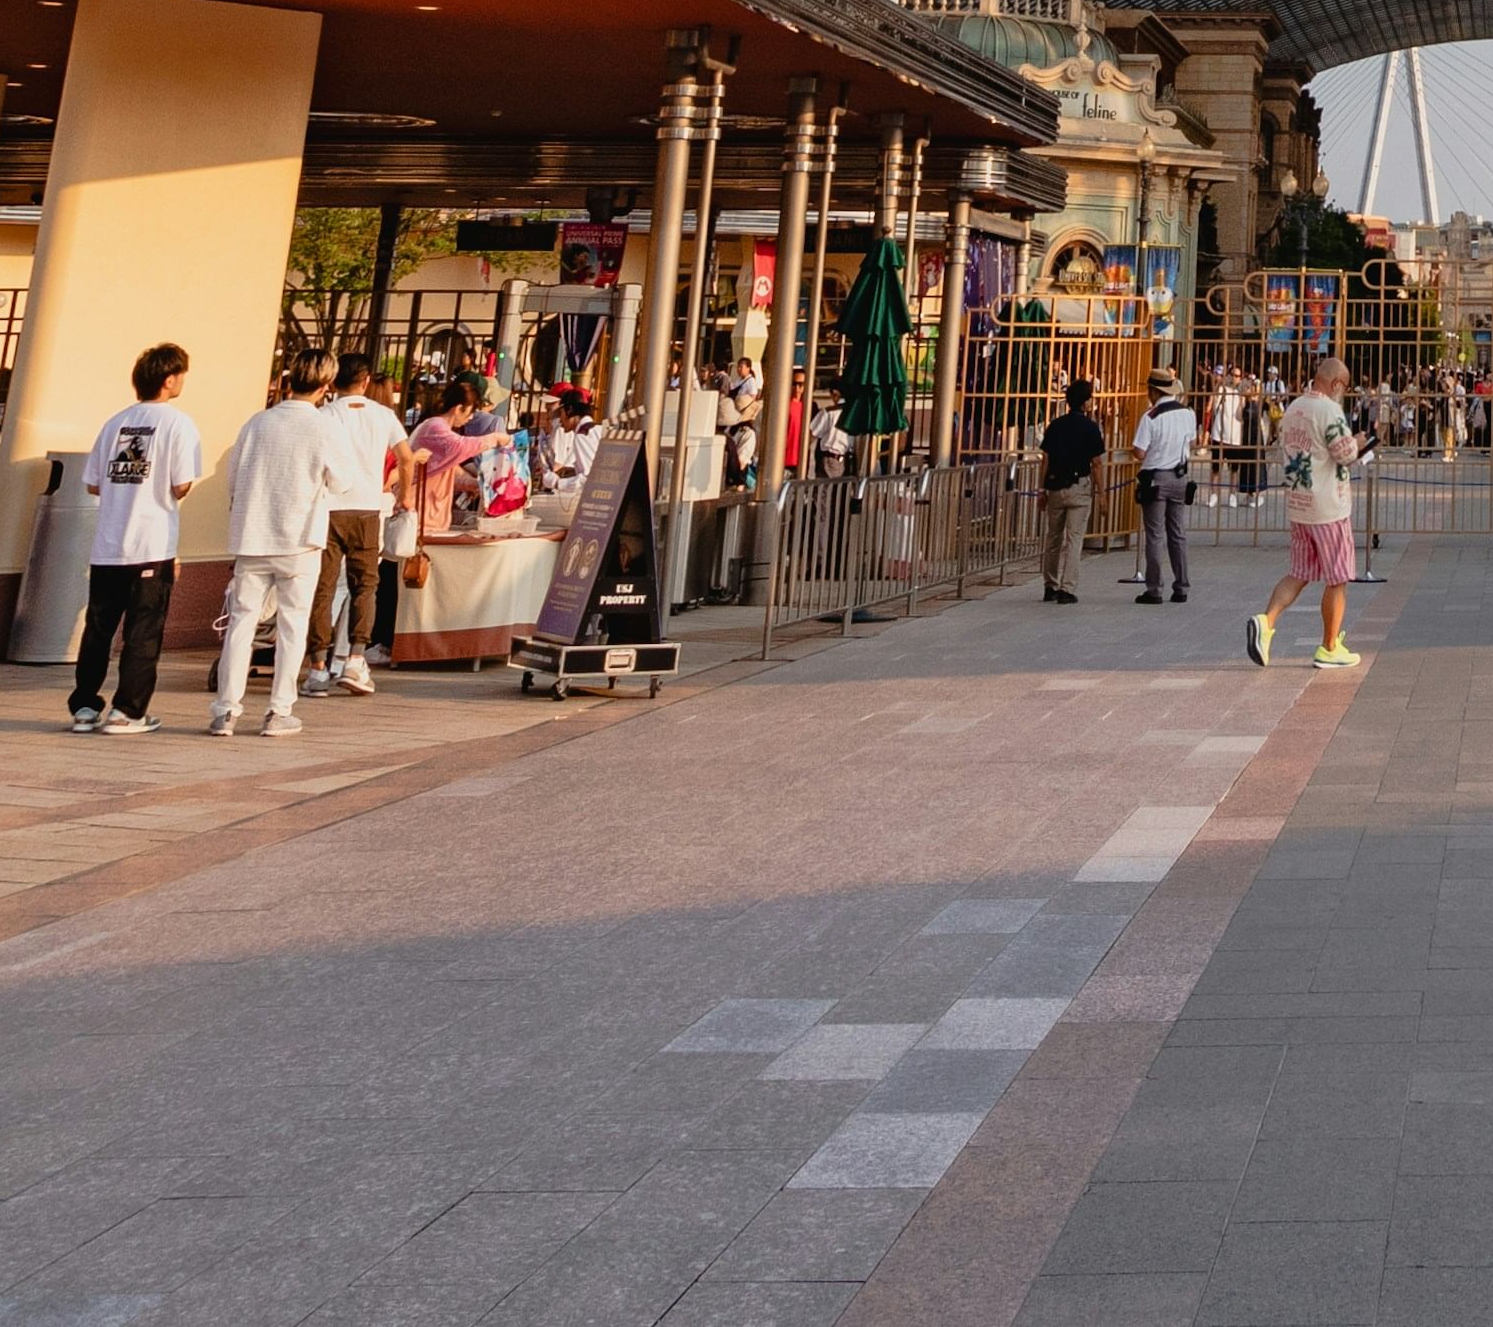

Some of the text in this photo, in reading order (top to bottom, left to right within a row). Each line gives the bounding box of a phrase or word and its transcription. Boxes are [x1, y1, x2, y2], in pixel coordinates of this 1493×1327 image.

[1082, 93, 1117, 120] feline
[565, 237, 601, 245] ANNUAL
[616, 584, 634, 594] USJ
[599, 595, 647, 605] PROPERTY
